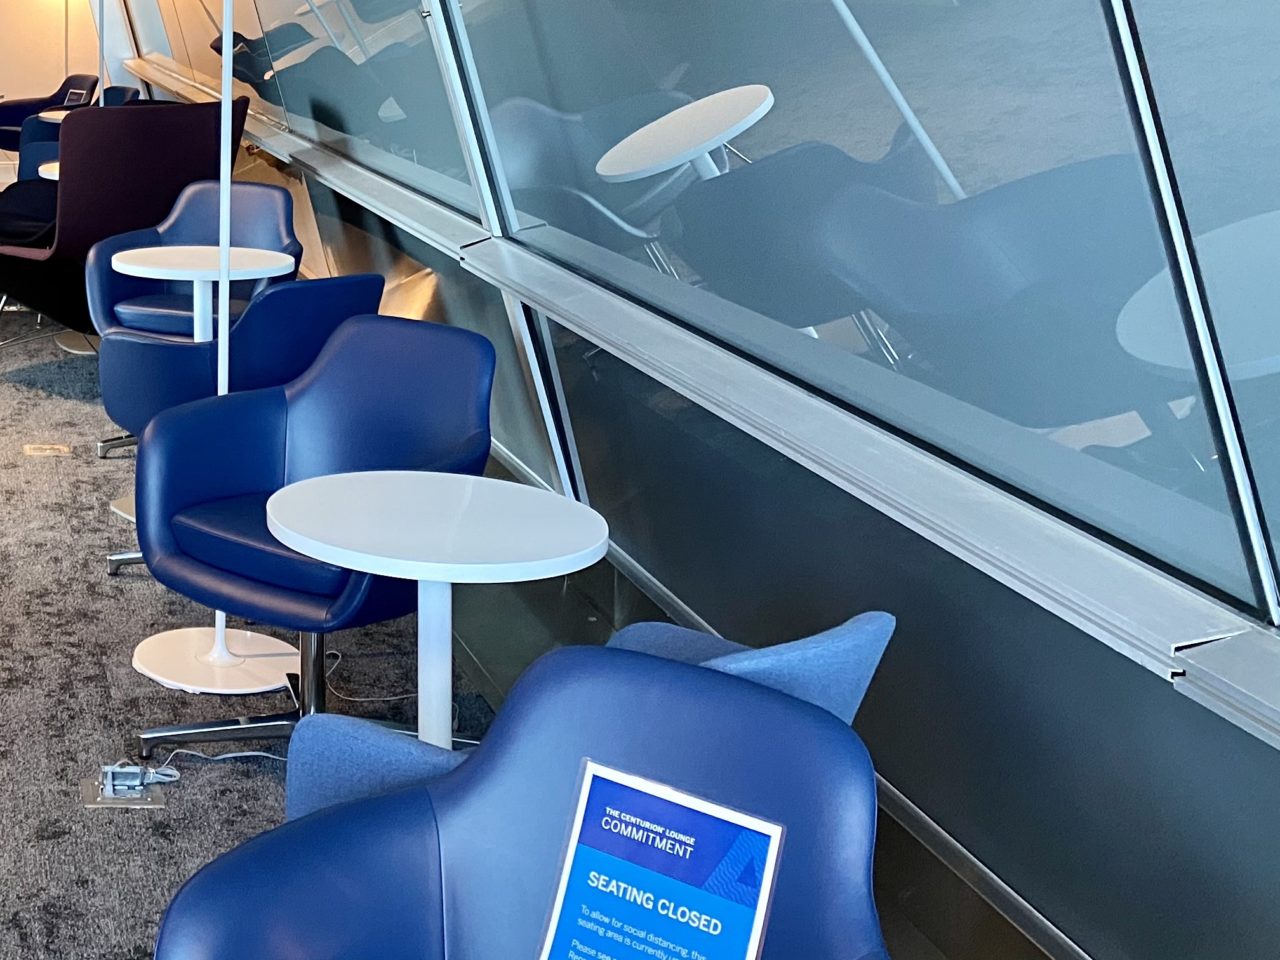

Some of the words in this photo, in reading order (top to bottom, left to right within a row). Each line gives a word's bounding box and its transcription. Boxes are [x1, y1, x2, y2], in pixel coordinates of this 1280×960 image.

[601, 816, 694, 860] COMMITMENT
[605, 806, 620, 818] THE
[665, 828, 696, 846] LOUNGE
[581, 904, 590, 916] To
[590, 910, 611, 924] allow
[611, 917, 623, 929] for
[623, 924, 647, 938] social
[587, 871, 655, 910] SEATING
[657, 898, 722, 936] CLOSED
[571, 938, 597, 957] Please
[577, 918, 606, 937] seating
[605, 930, 624, 943] area
[623, 936, 631, 946] is
[631, 941, 668, 960] currently
